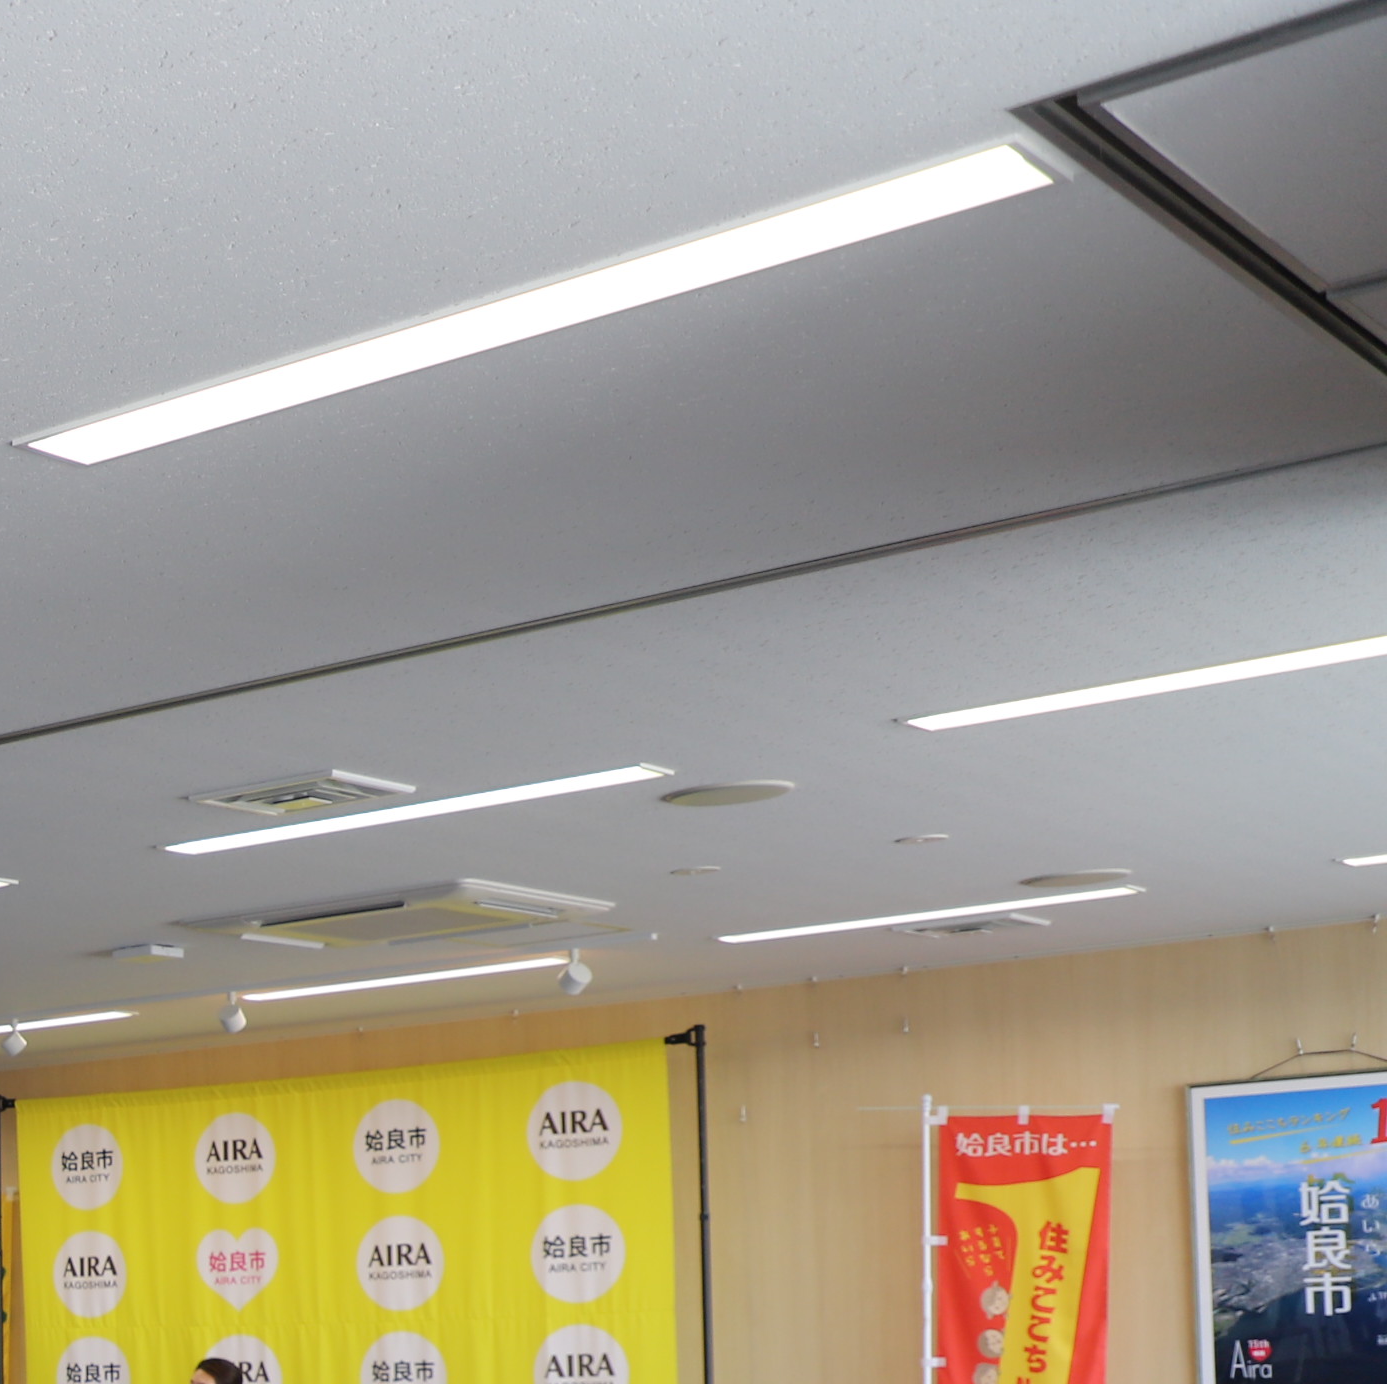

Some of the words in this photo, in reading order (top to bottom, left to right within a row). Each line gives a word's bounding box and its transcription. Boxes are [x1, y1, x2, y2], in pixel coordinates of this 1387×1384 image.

[539, 1108, 609, 1135] AIRA
[206, 1138, 263, 1162] AIRA
[364, 1126, 426, 1152] 姶良市
[539, 1136, 610, 1150] KAGOSHIMA
[61, 1148, 113, 1172] 姶良市
[206, 1163, 263, 1175] KAGOSHIMA
[371, 1155, 395, 1165] AIRA
[397, 1152, 422, 1164] CITY
[66, 1175, 87, 1184] AIRA
[88, 1173, 111, 1185] CITY
[369, 1243, 432, 1267] AIRA
[542, 1234, 611, 1259] 姶良市
[1298, 1179, 1353, 1317] 姶良市
[63, 1255, 117, 1278] AIRA
[209, 1250, 266, 1273] 姶良市
[548, 1263, 577, 1273] AIRA
[579, 1261, 606, 1273] CITY
[63, 1280, 118, 1290] KAGOSHIMA
[214, 1276, 237, 1285] AIRA
[240, 1275, 263, 1286] CITY
[368, 1269, 432, 1281] KAGOSHIMA
[545, 1353, 615, 1378] AIRA
[1229, 1339, 1273, 1380] Aira
[66, 1363, 120, 1384] 姶良市
[240, 1361, 271, 1382] RA
[371, 1360, 434, 1383] 姶良市
